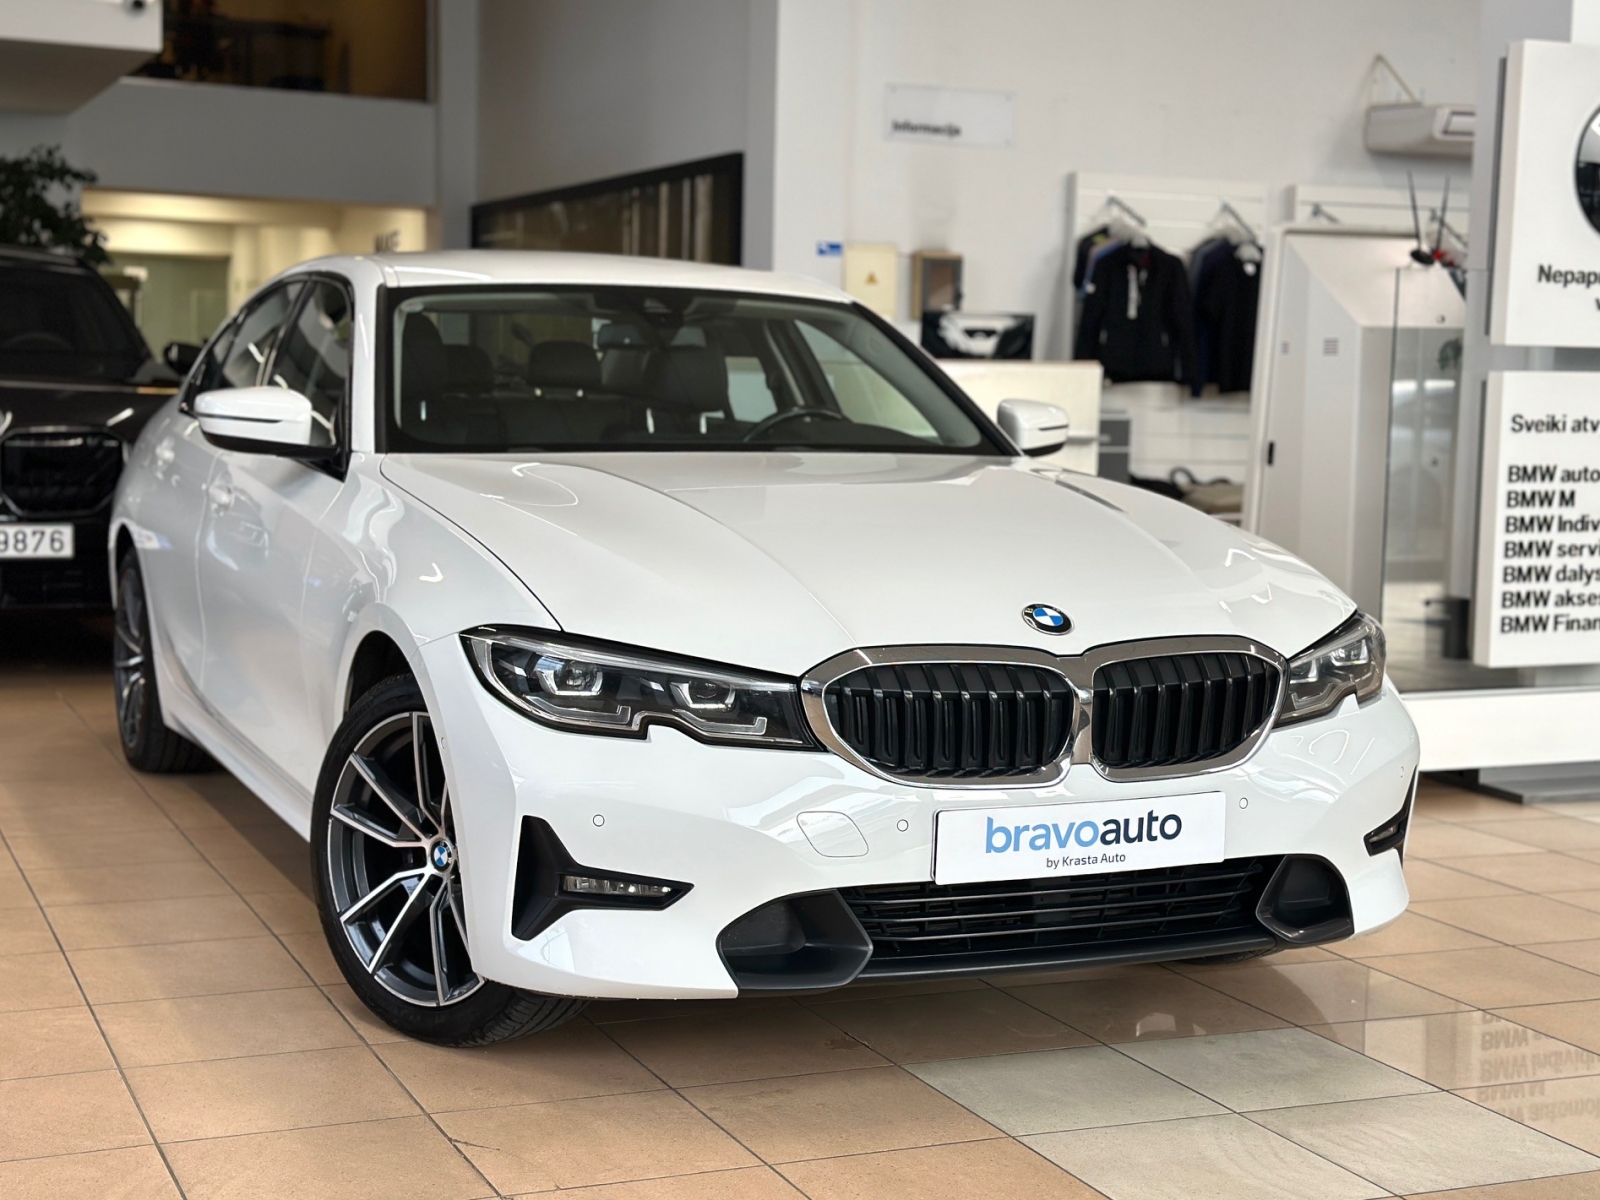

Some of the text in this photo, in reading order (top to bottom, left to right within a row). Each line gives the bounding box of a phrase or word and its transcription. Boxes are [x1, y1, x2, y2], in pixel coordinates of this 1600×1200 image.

[1538, 263, 1600, 289] Nepap
[1511, 413, 1600, 433] Sveiki atv
[1508, 464, 1600, 483] BMW auto
[1506, 490, 1575, 508] BMW M
[1505, 514, 1600, 533] BMW Indiv
[0, 530, 65, 553] 9876
[1504, 540, 1553, 559] BMW
[1502, 565, 1552, 583] BMW
[1501, 590, 1551, 608] BMW
[1500, 614, 1550, 634] BMW
[985, 809, 1182, 854] bravoauto
[1046, 853, 1126, 869] by Krasta Auto
